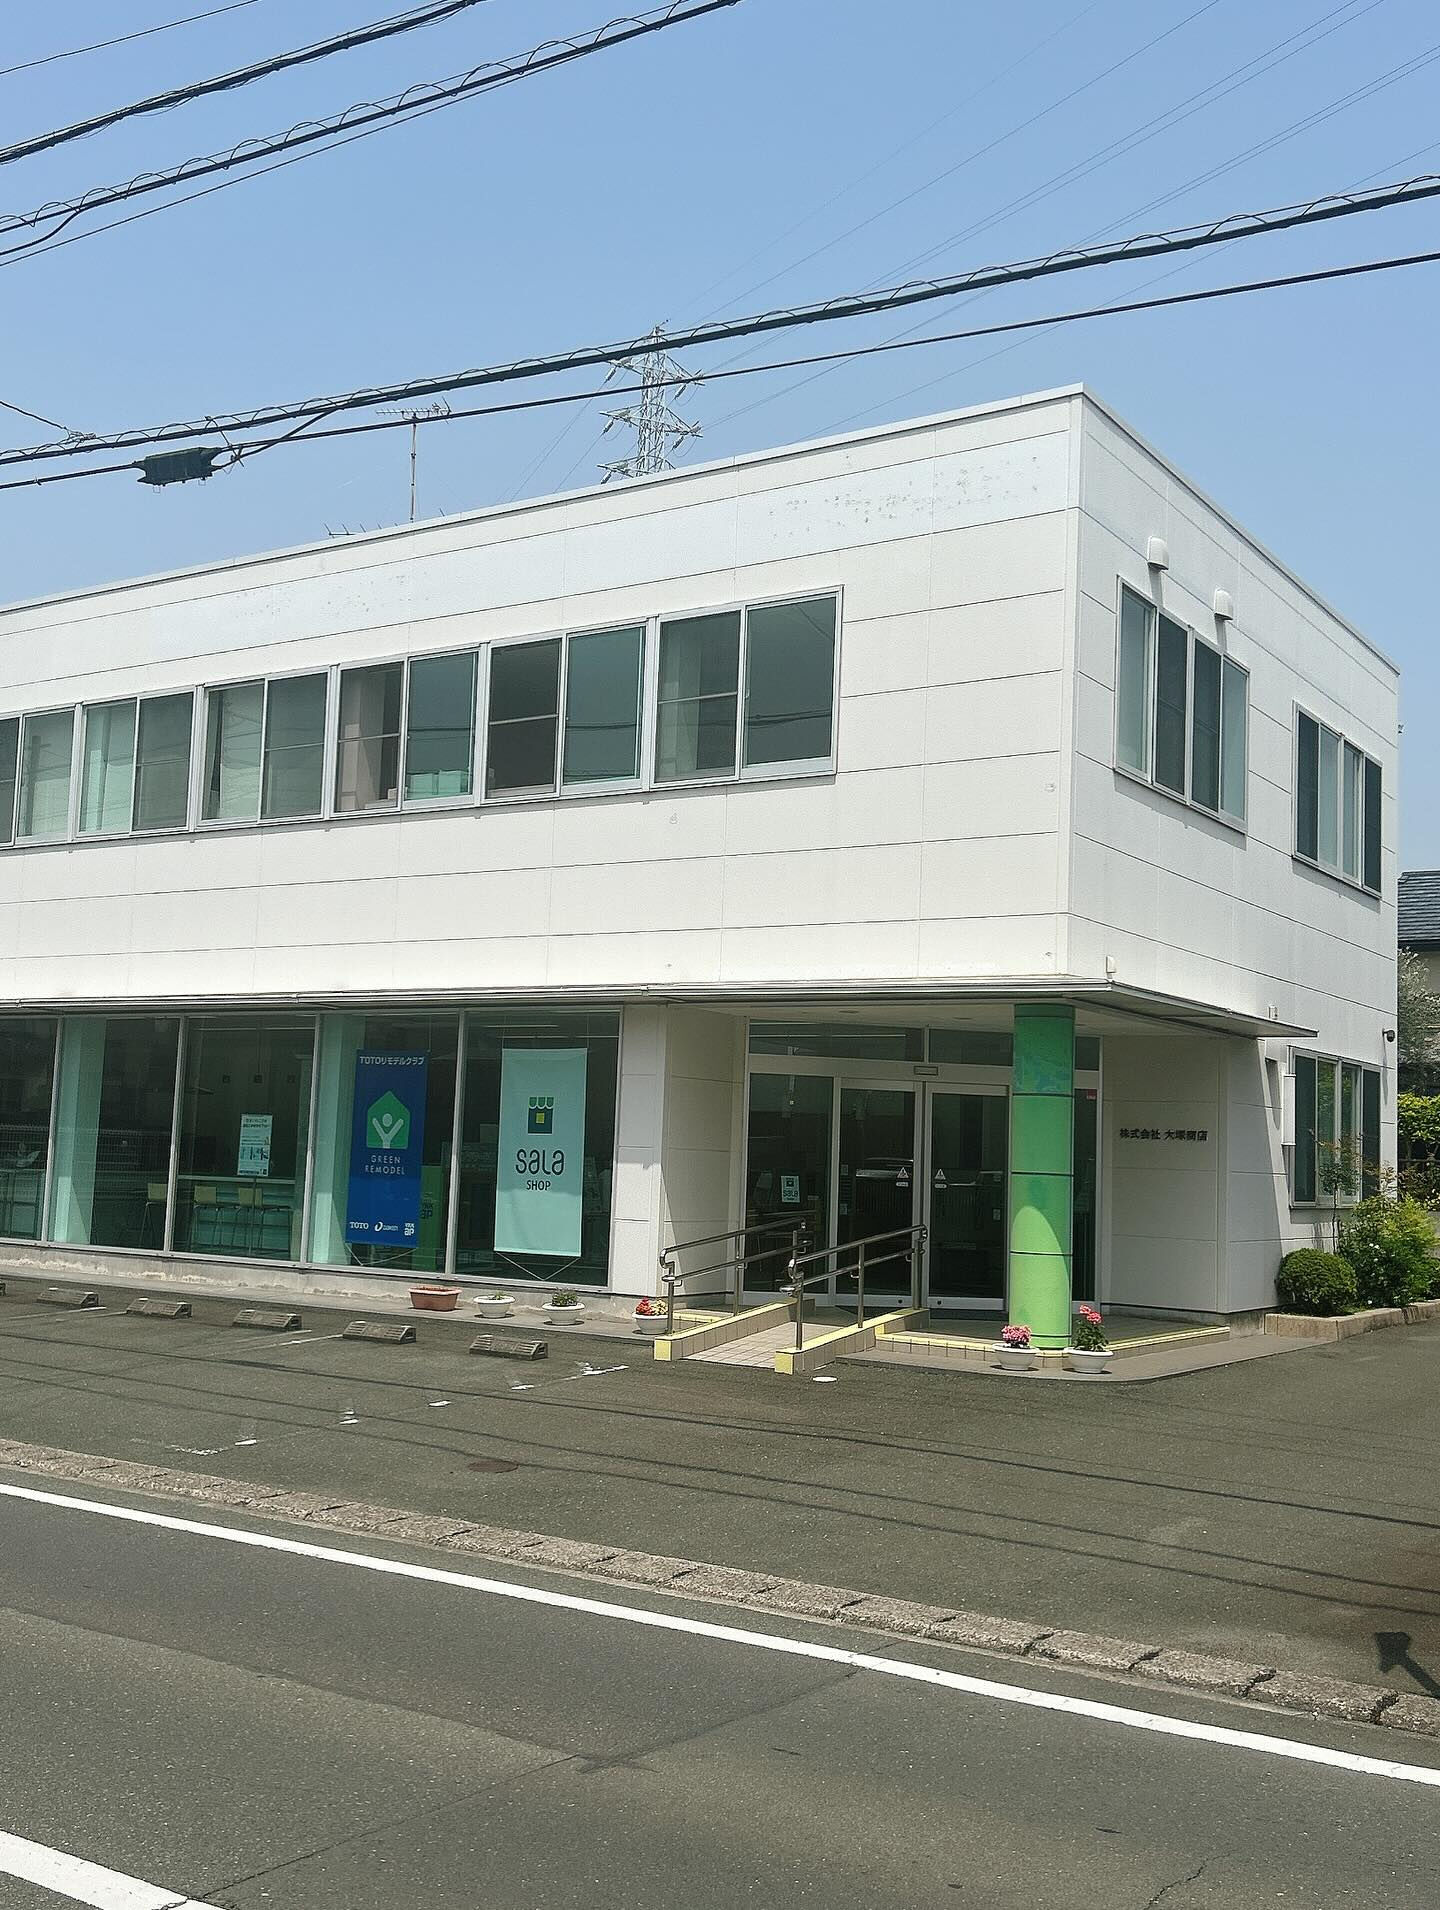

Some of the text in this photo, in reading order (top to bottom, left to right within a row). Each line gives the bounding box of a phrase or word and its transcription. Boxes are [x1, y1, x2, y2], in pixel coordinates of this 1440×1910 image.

[359, 1056, 425, 1066] TOTOリモデルクラブ
[370, 1154, 401, 1164] GREEN
[364, 1164, 406, 1175] REMODEL
[526, 1179, 552, 1191] SHOP
[349, 1221, 370, 1230] TOTO
